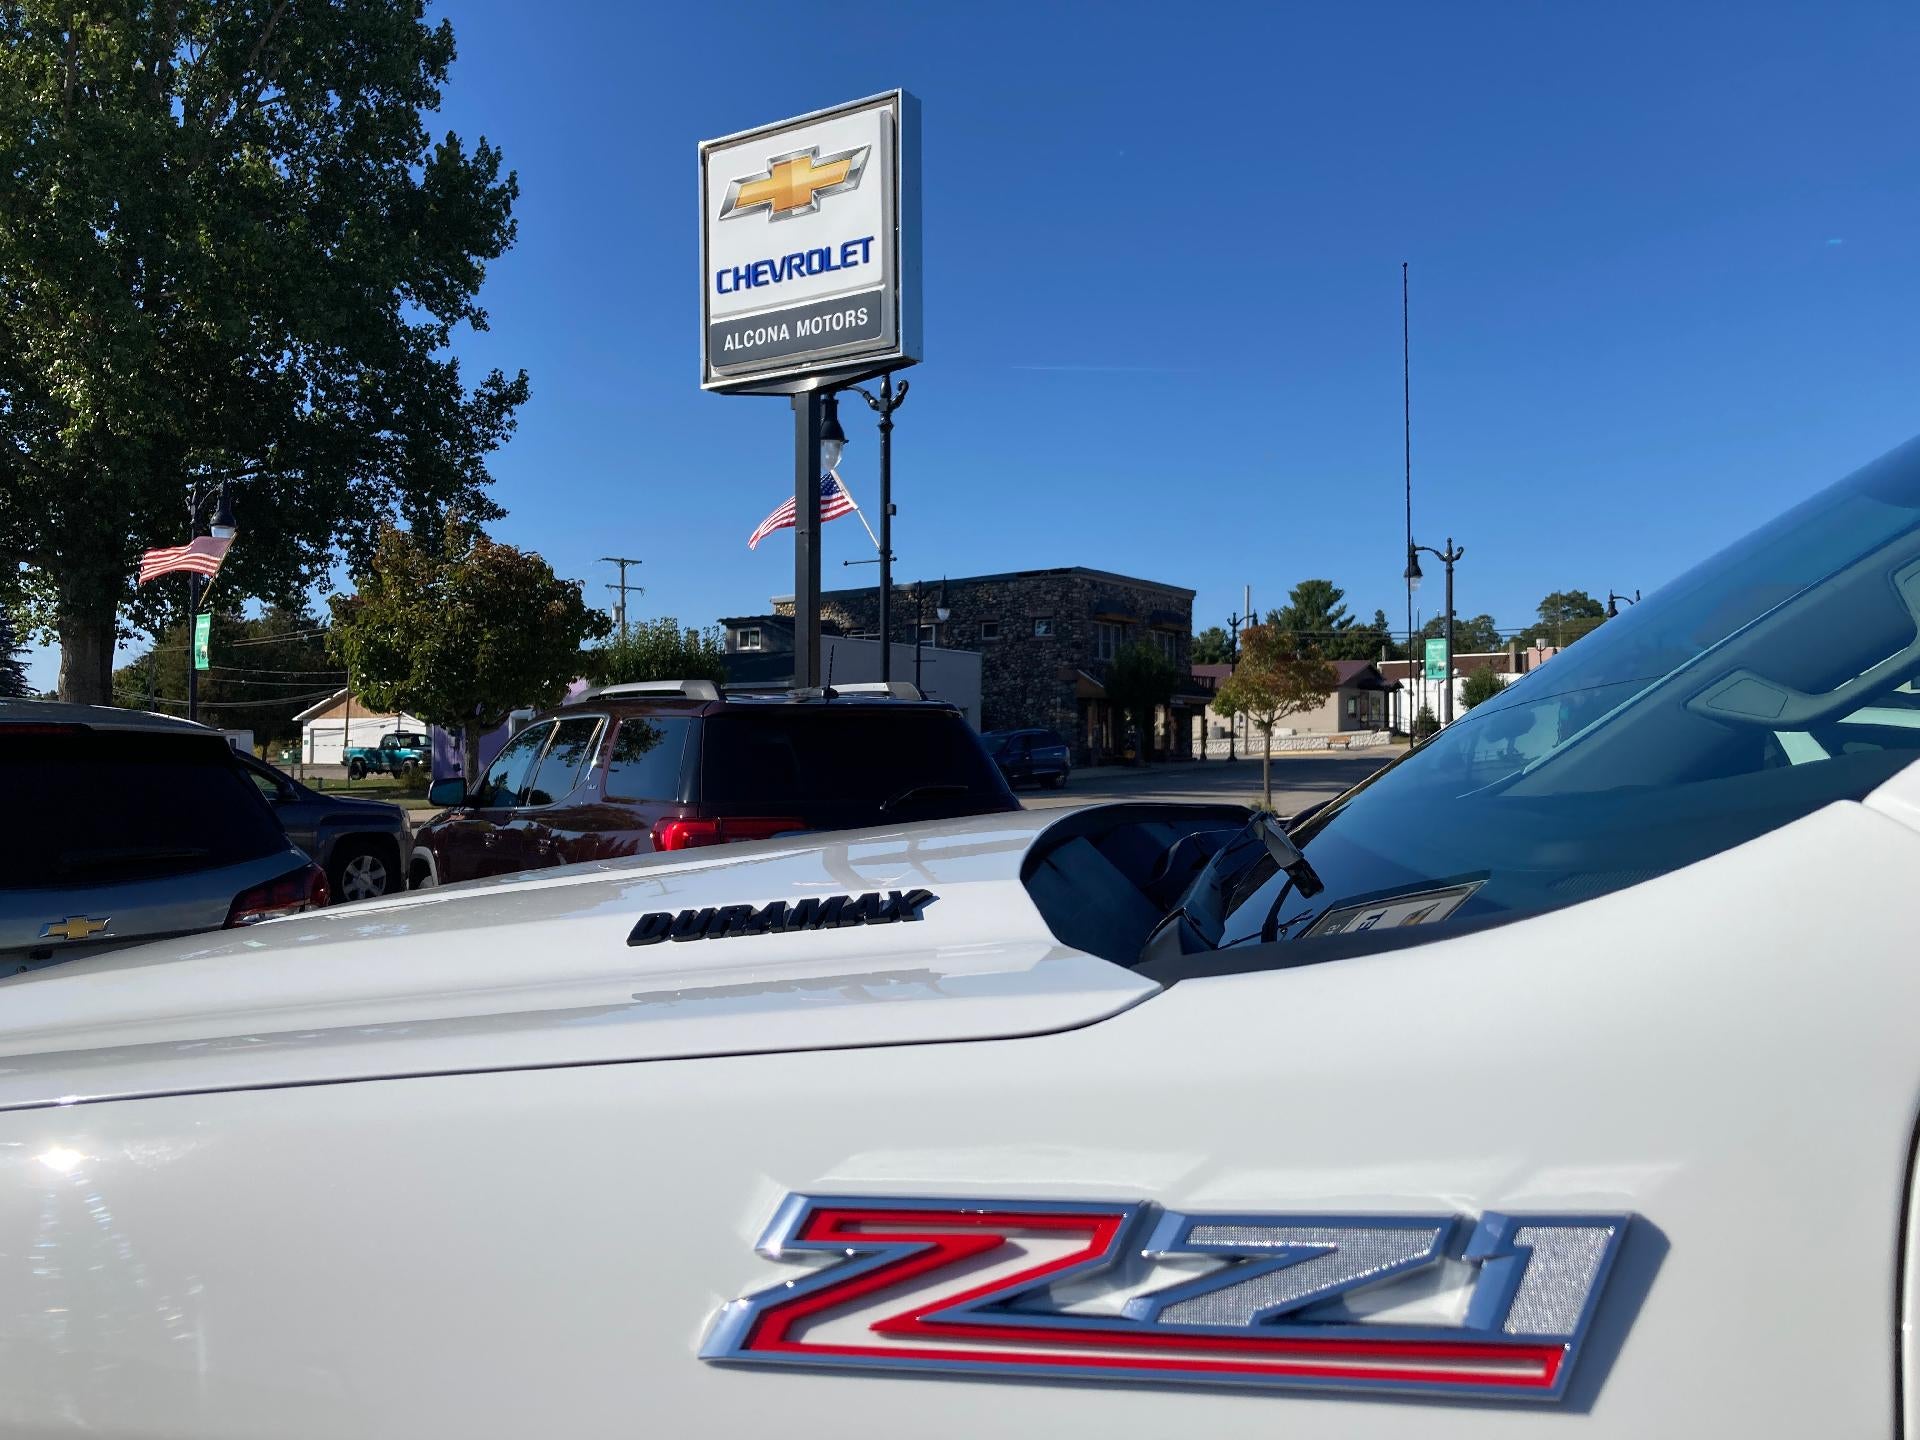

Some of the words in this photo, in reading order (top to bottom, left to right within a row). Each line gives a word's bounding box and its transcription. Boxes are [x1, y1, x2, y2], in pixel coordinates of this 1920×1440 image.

[716, 236, 875, 294] CHEVROLET
[724, 322, 790, 352] ALCONA
[796, 307, 868, 338] MOTORS
[627, 889, 935, 947] DURAMAX
[698, 1193, 1637, 1402] Z71
